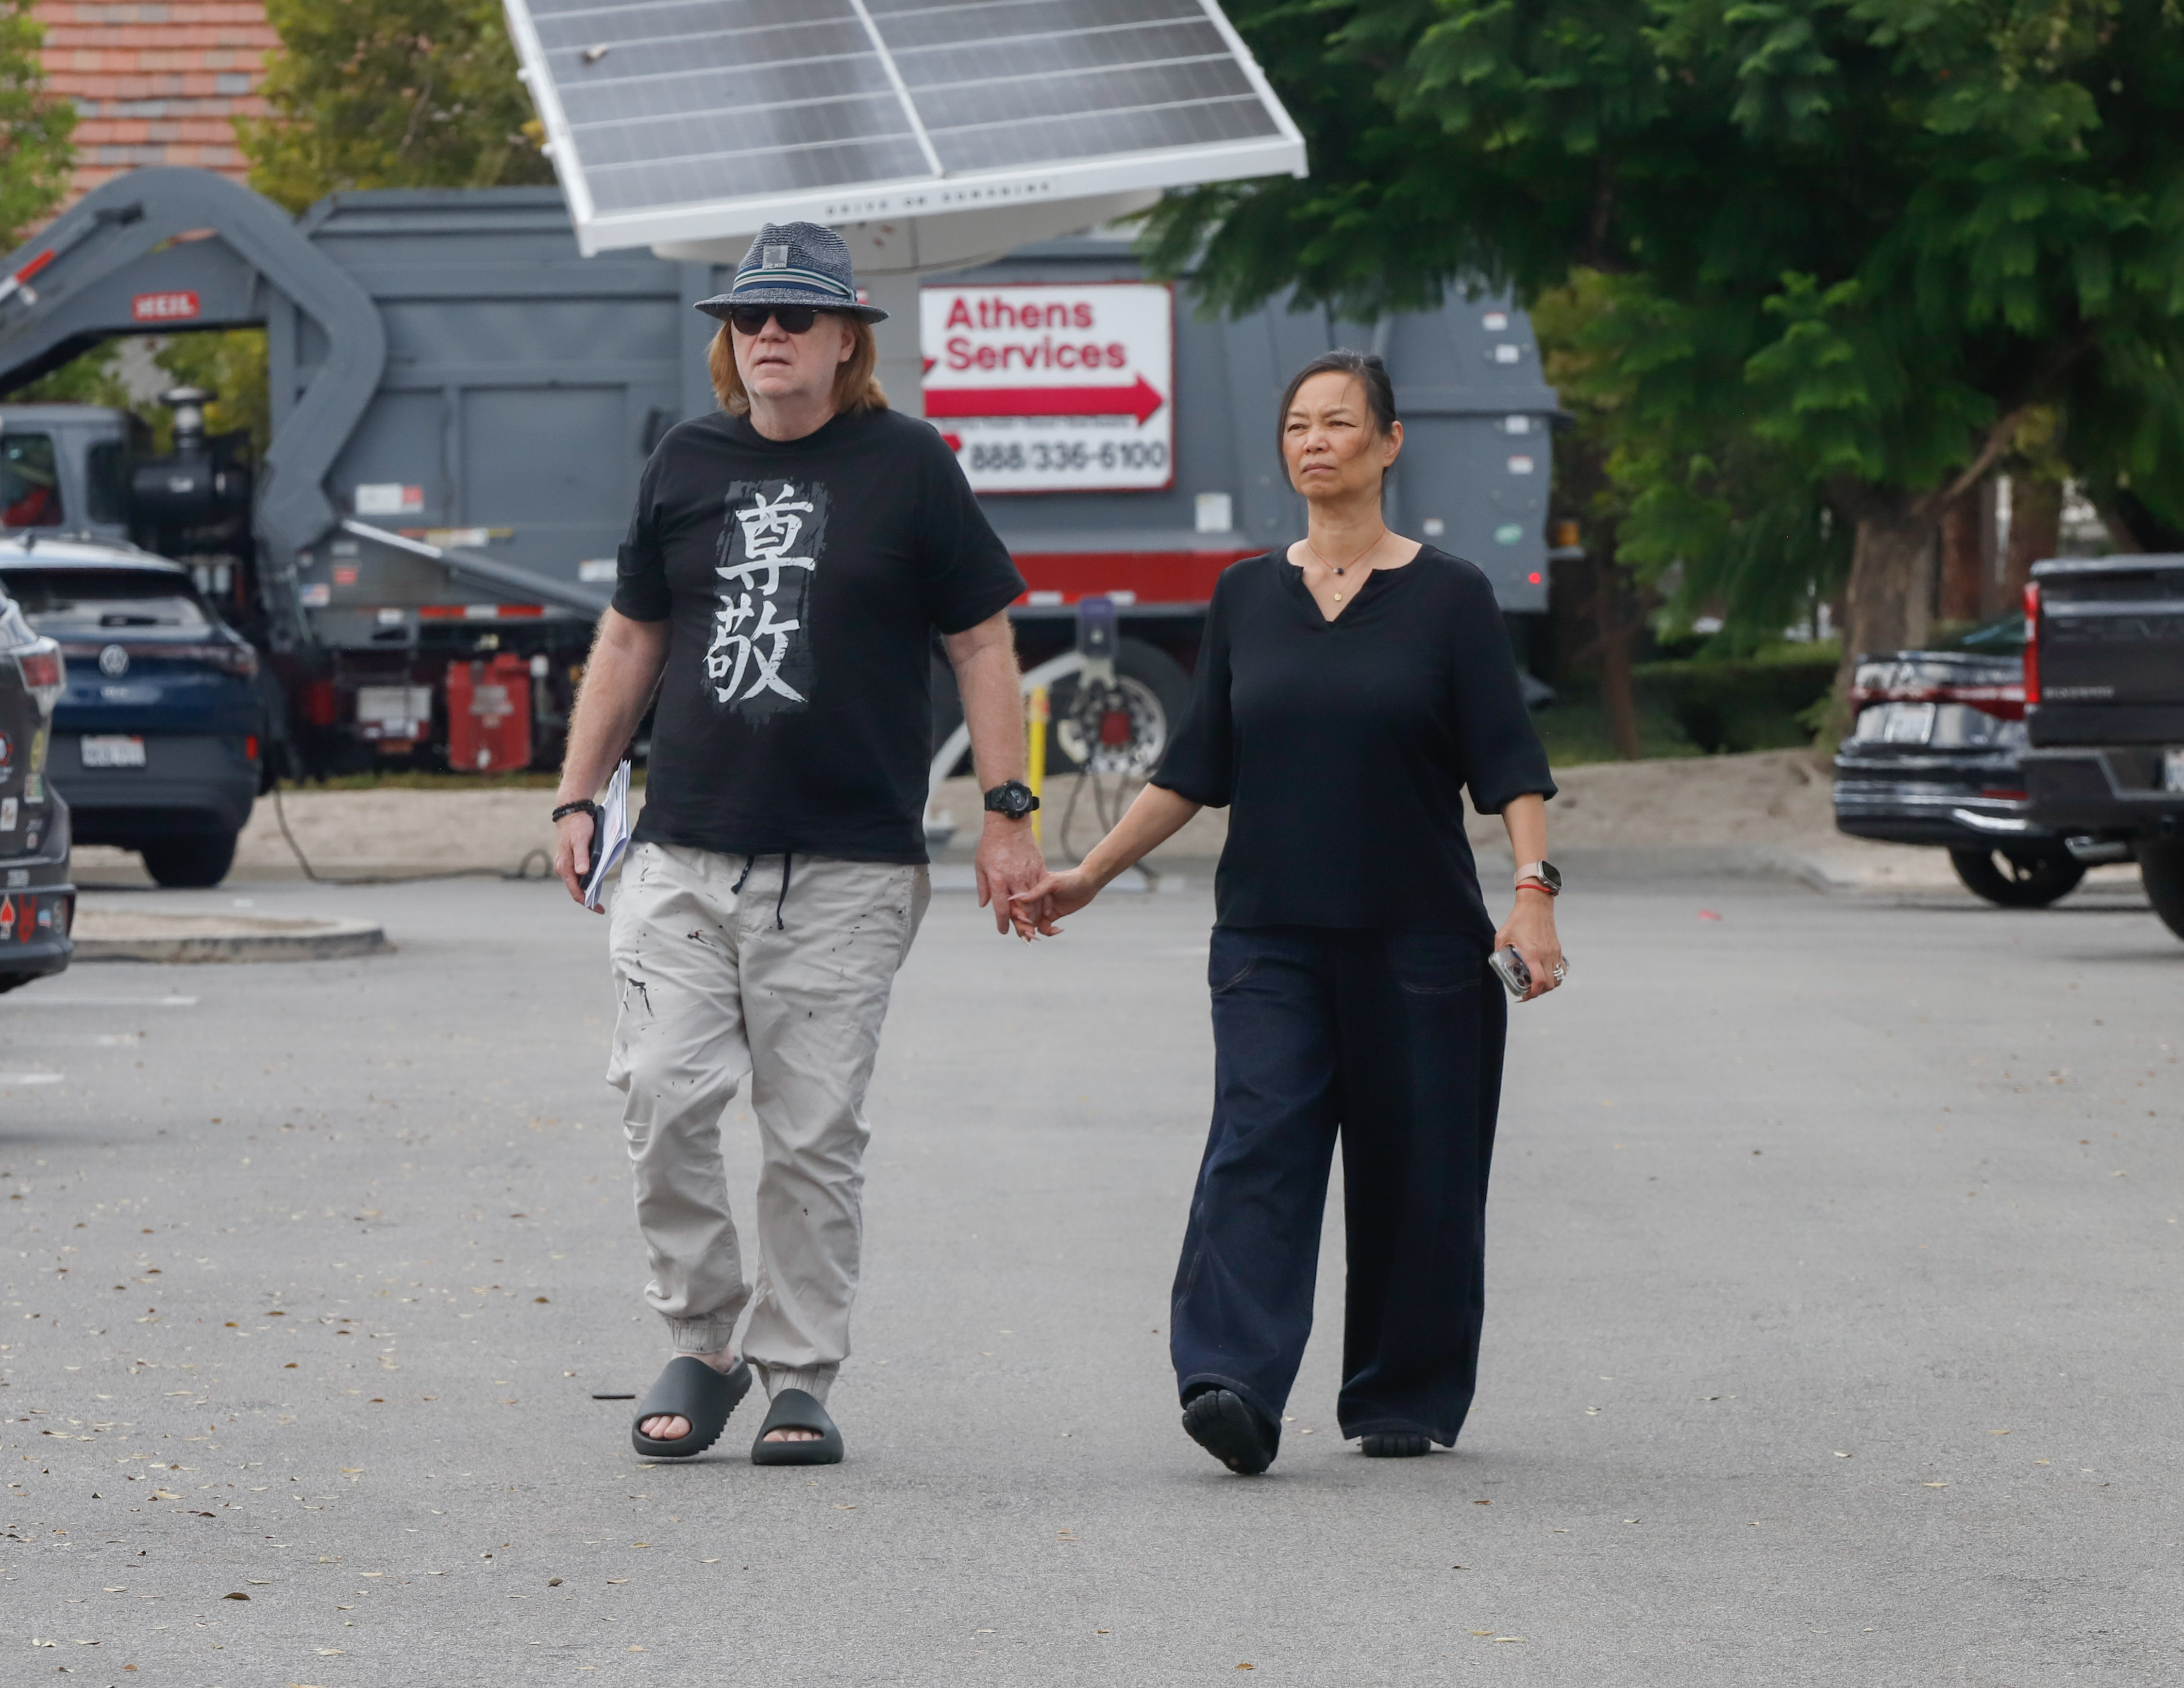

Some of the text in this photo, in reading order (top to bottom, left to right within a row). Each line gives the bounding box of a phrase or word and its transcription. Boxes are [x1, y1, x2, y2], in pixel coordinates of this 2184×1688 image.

[945, 295, 1094, 330] Athens
[946, 334, 1126, 371] Services
[1031, 439, 1166, 470] 336-6100
[702, 483, 816, 703] 尊敬
